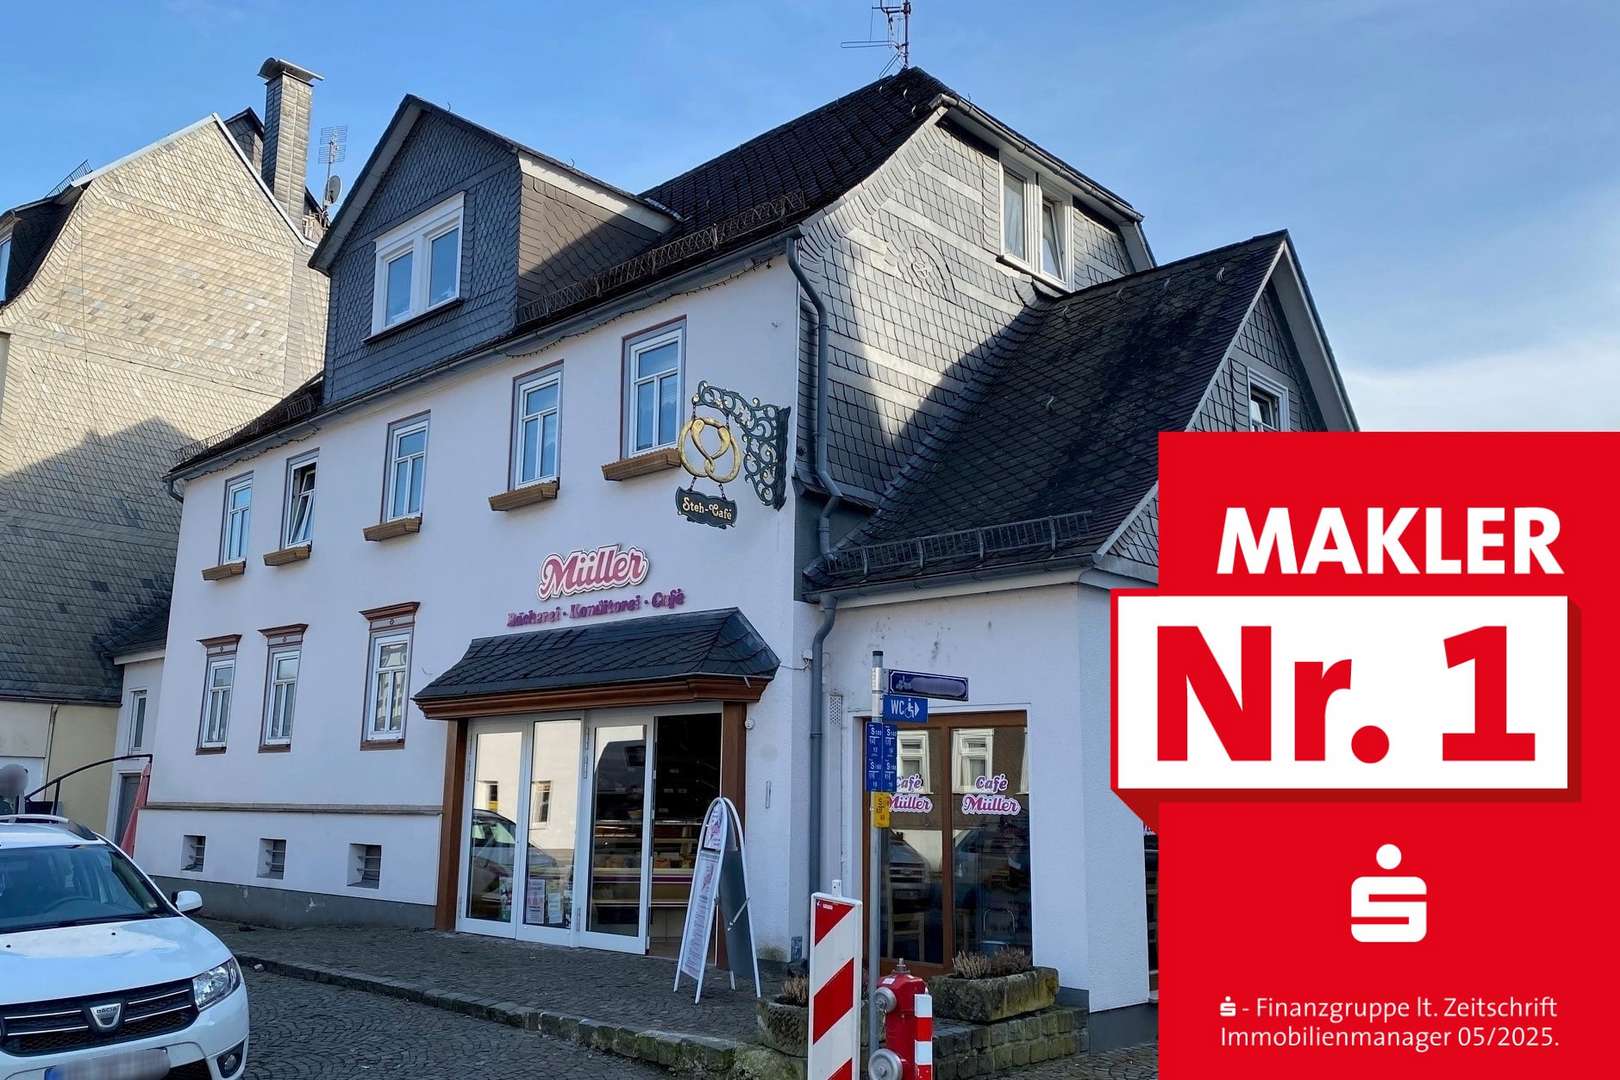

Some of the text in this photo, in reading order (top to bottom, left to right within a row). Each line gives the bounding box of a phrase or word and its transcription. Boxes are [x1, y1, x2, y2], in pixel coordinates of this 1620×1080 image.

[682, 497, 732, 519] Steh-Café
[539, 547, 647, 597] Müller
[569, 595, 641, 618] Konditorei
[651, 588, 686, 609] Café
[891, 699, 905, 715] WC
[976, 774, 1008, 792] Café
[964, 795, 1019, 814] Müller
